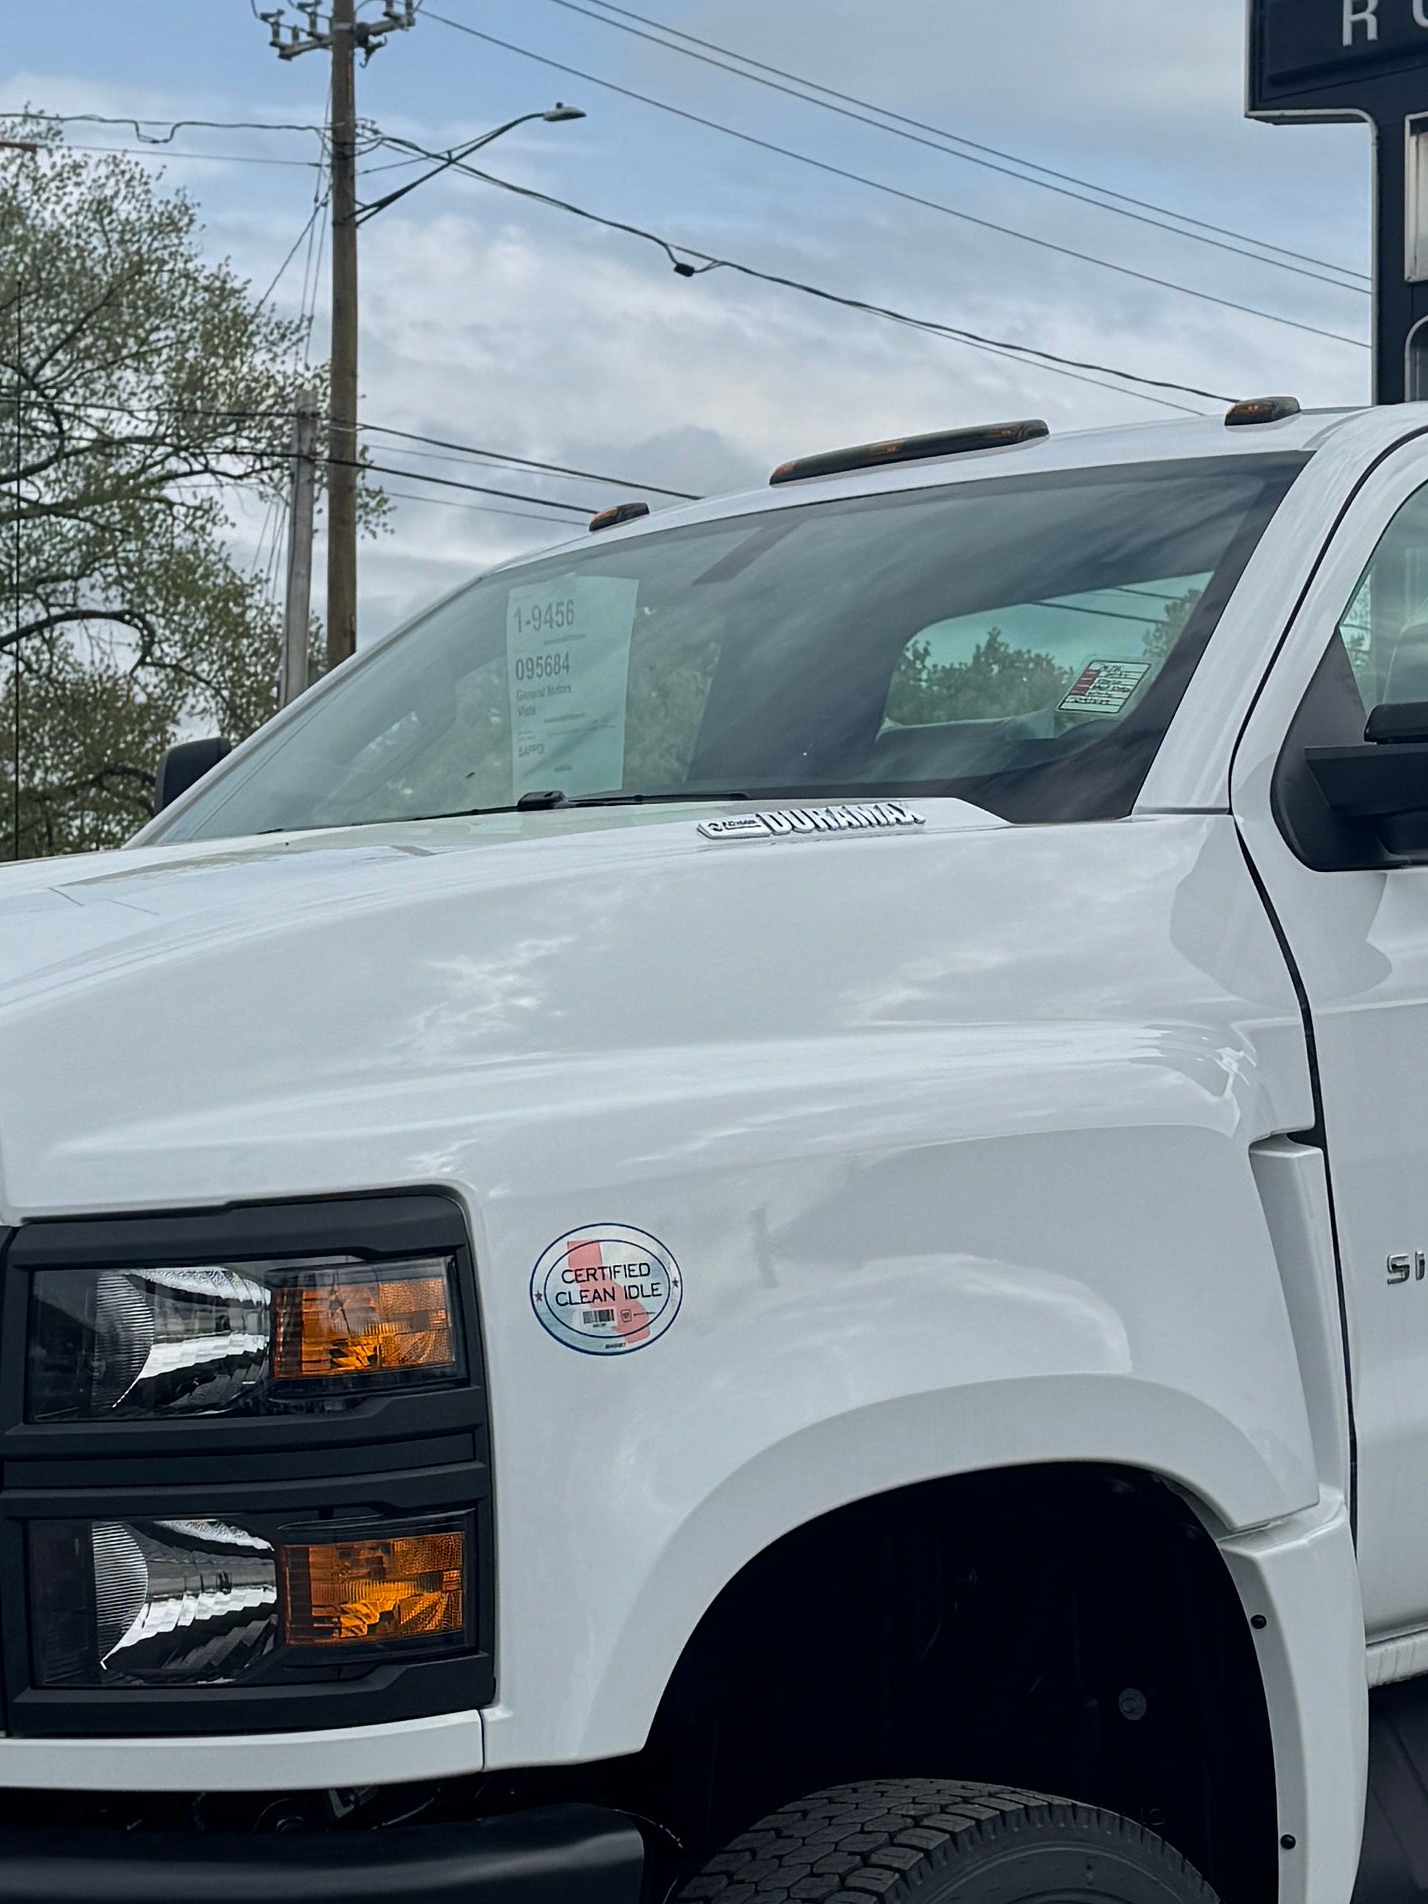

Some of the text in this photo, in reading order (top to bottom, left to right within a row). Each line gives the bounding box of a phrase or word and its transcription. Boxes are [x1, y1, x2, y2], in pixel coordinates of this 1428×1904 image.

[514, 600, 575, 633] 1-9456
[516, 652, 570, 680] 095684
[756, 801, 927, 835] DURAMAX
[561, 1262, 651, 1284] CERTIFIED
[555, 1282, 663, 1307] CLEAN IDLE
